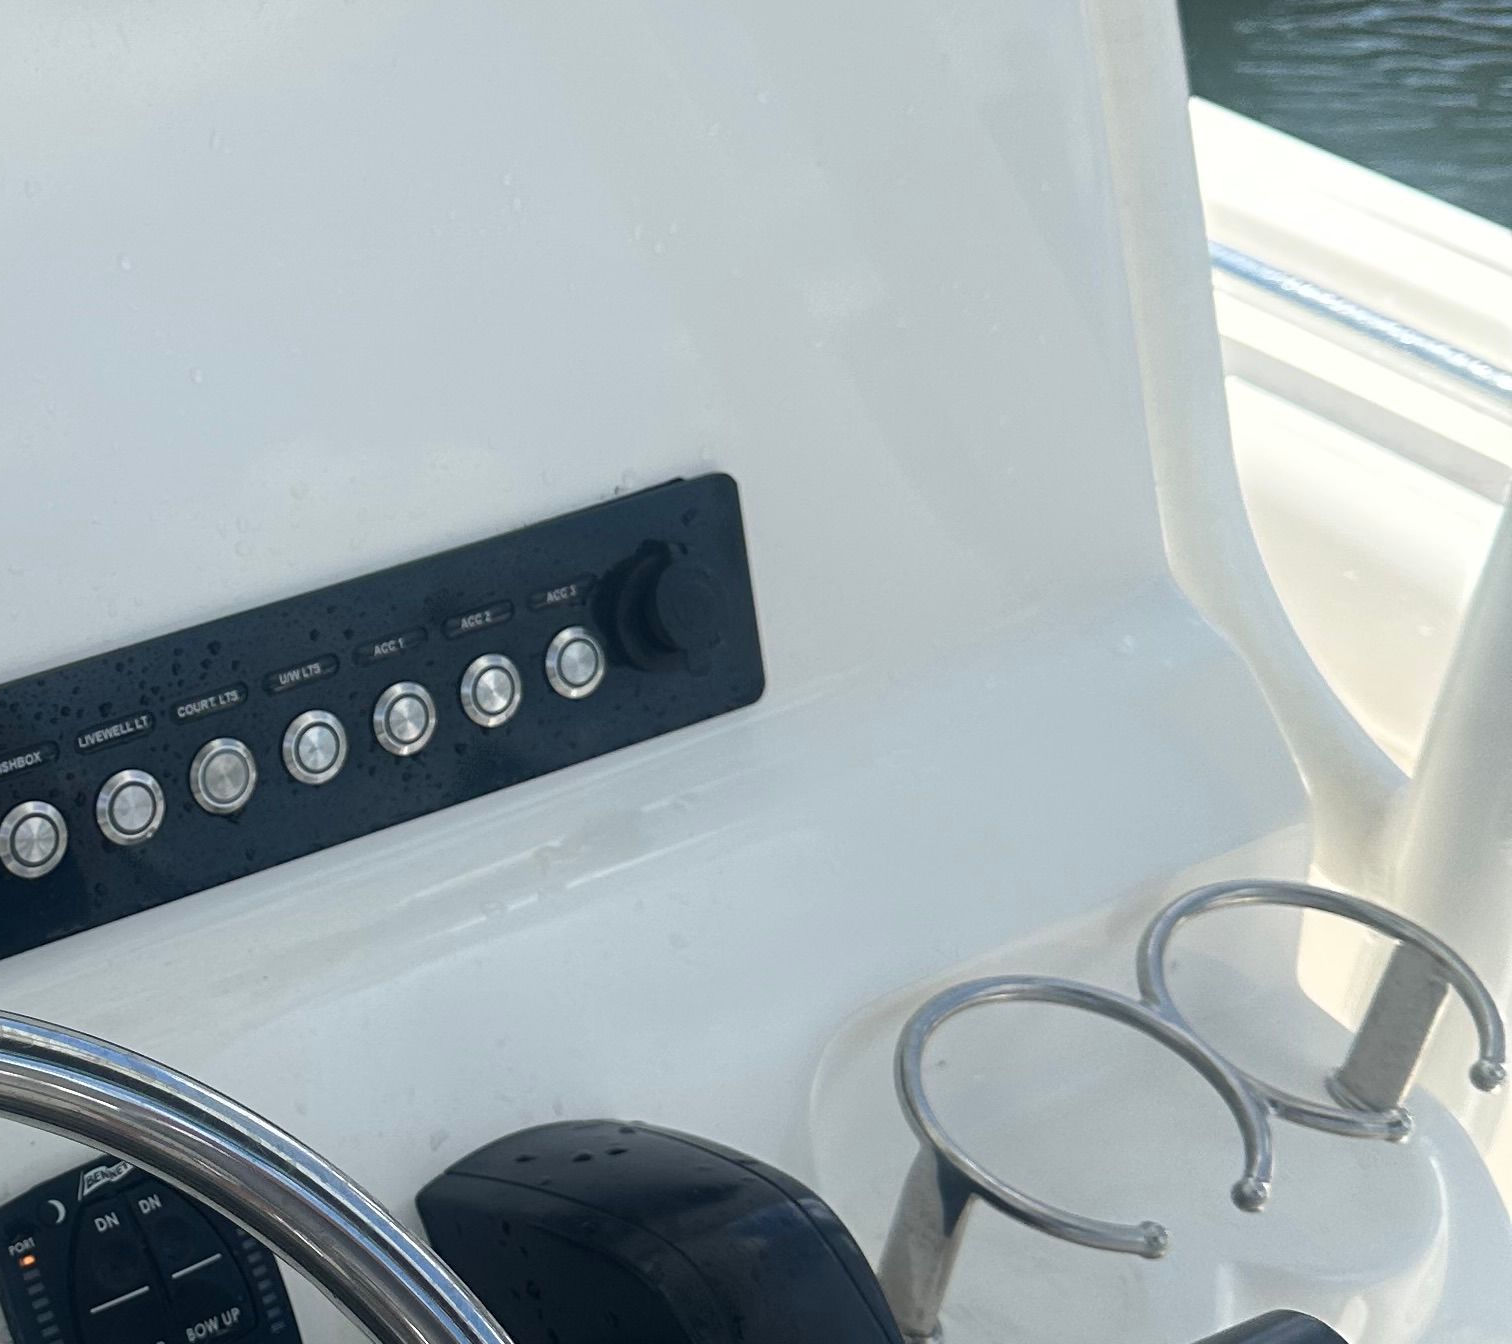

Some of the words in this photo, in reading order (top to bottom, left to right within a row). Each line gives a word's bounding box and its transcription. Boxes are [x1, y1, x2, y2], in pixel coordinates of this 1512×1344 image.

[546, 587, 569, 604] ACC
[460, 613, 484, 630] ACC
[374, 639, 397, 656] ACC
[302, 661, 321, 678] LTS
[177, 698, 216, 718] COURT
[78, 721, 133, 749] LIVEWELL
[134, 715, 149, 729] LT
[138, 1194, 162, 1214] DN
[94, 1212, 121, 1233] DN
[8, 1237, 36, 1256] PORT
[186, 1316, 220, 1343] BOW
[221, 1307, 241, 1327] UP
